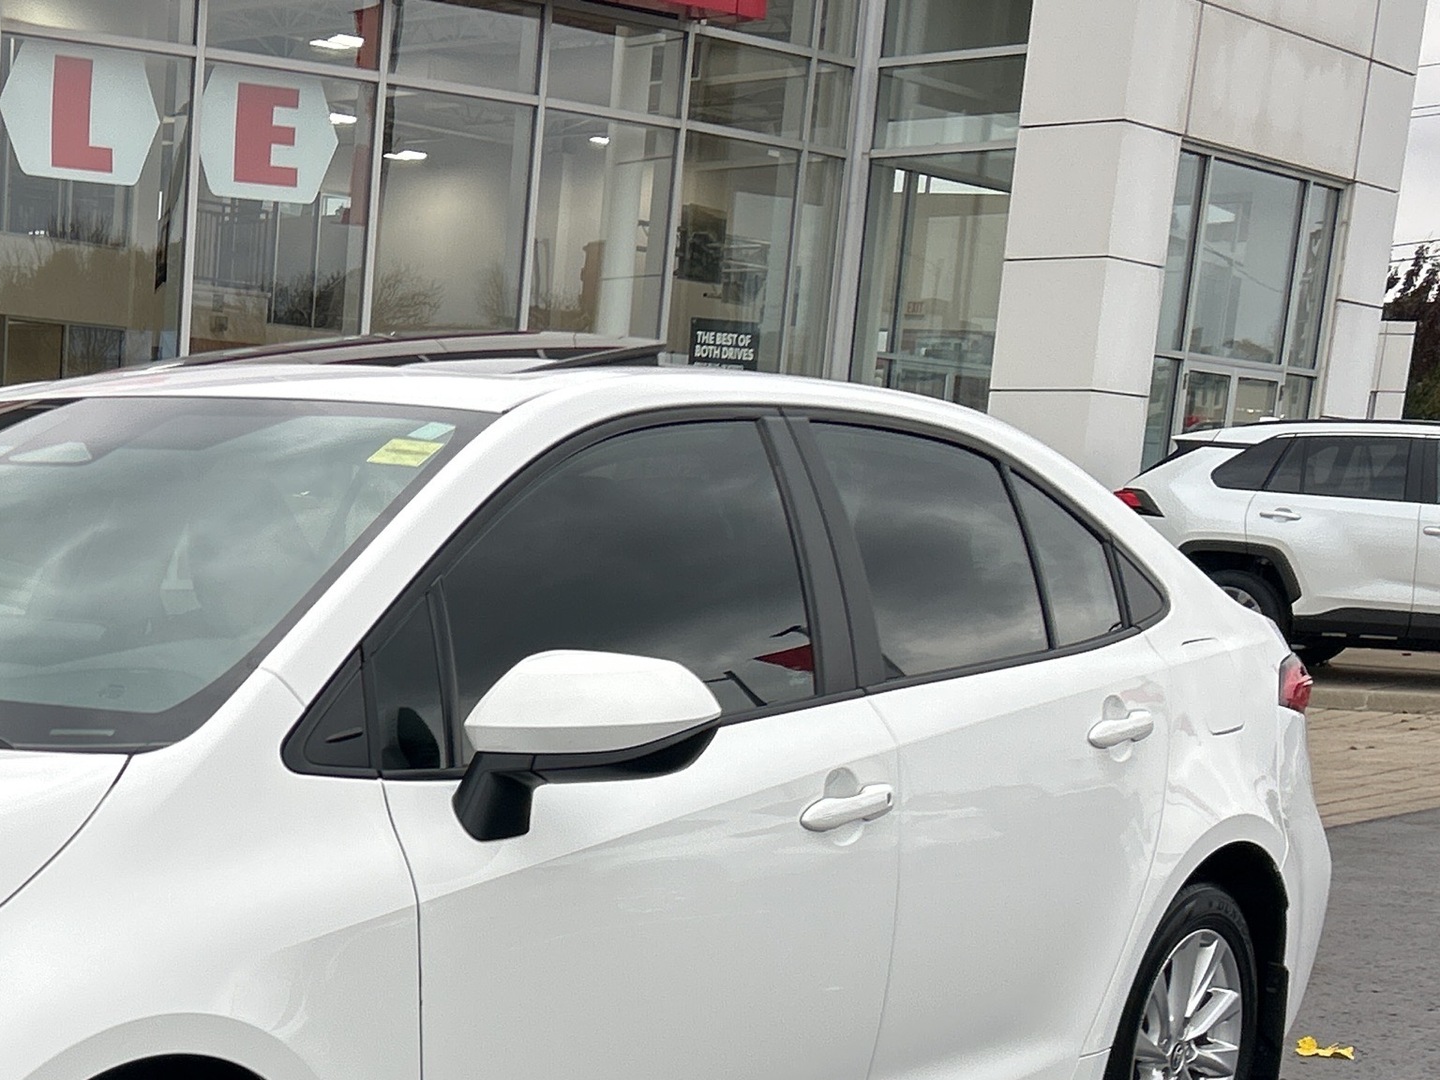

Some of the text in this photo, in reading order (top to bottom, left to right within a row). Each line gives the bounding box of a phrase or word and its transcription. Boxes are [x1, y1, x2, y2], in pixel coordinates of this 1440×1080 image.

[696, 330, 752, 347] THE BEST OF
[694, 344, 754, 361] BOTH DRIVES
